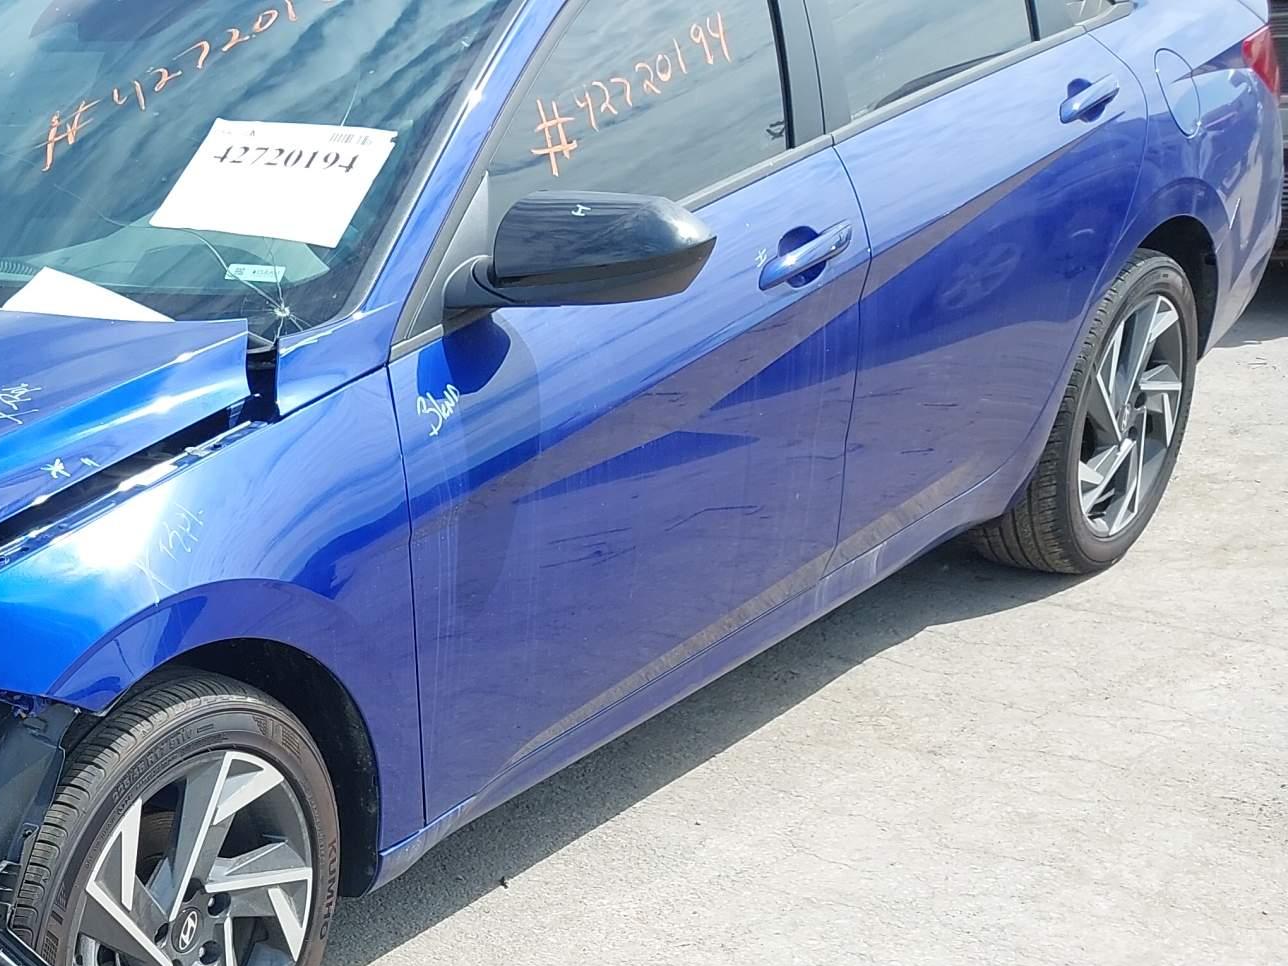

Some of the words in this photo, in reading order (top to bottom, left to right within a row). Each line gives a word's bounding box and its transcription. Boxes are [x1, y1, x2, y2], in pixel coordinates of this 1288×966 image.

[530, 11, 732, 177] #42720194
[213, 144, 360, 174] 42720194
[319, 838, 338, 940] KUMHO
